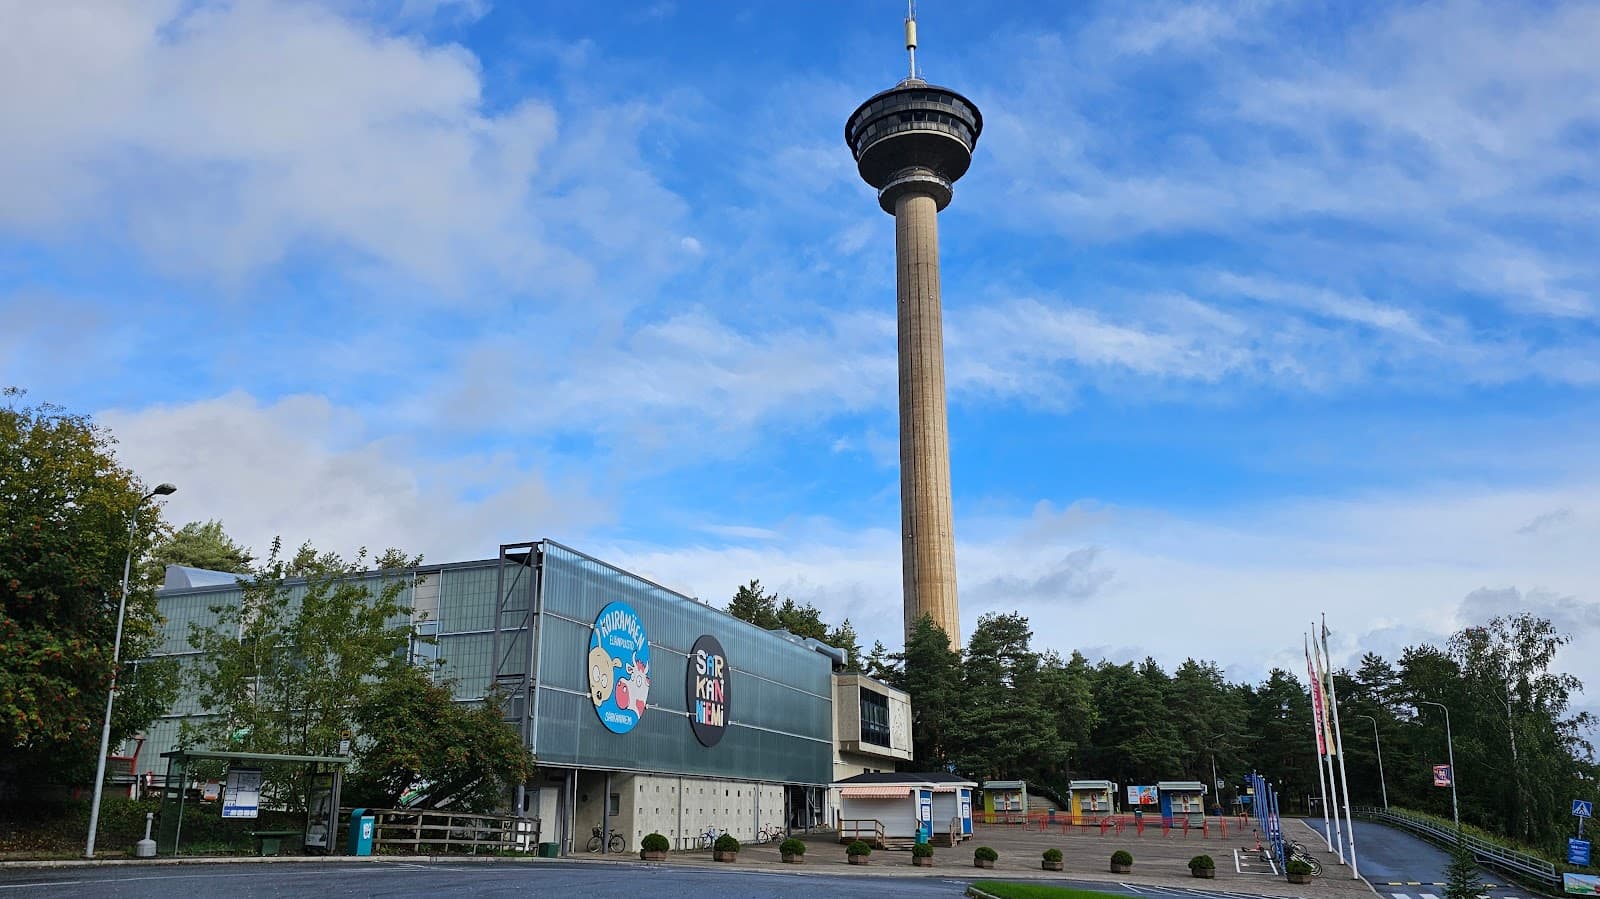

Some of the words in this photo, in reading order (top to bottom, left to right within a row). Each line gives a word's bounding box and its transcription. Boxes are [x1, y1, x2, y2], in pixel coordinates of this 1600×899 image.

[600, 610, 645, 650] KOIRAMÄEN
[696, 649, 724, 679] SÄR
[696, 675, 725, 703] KÄN
